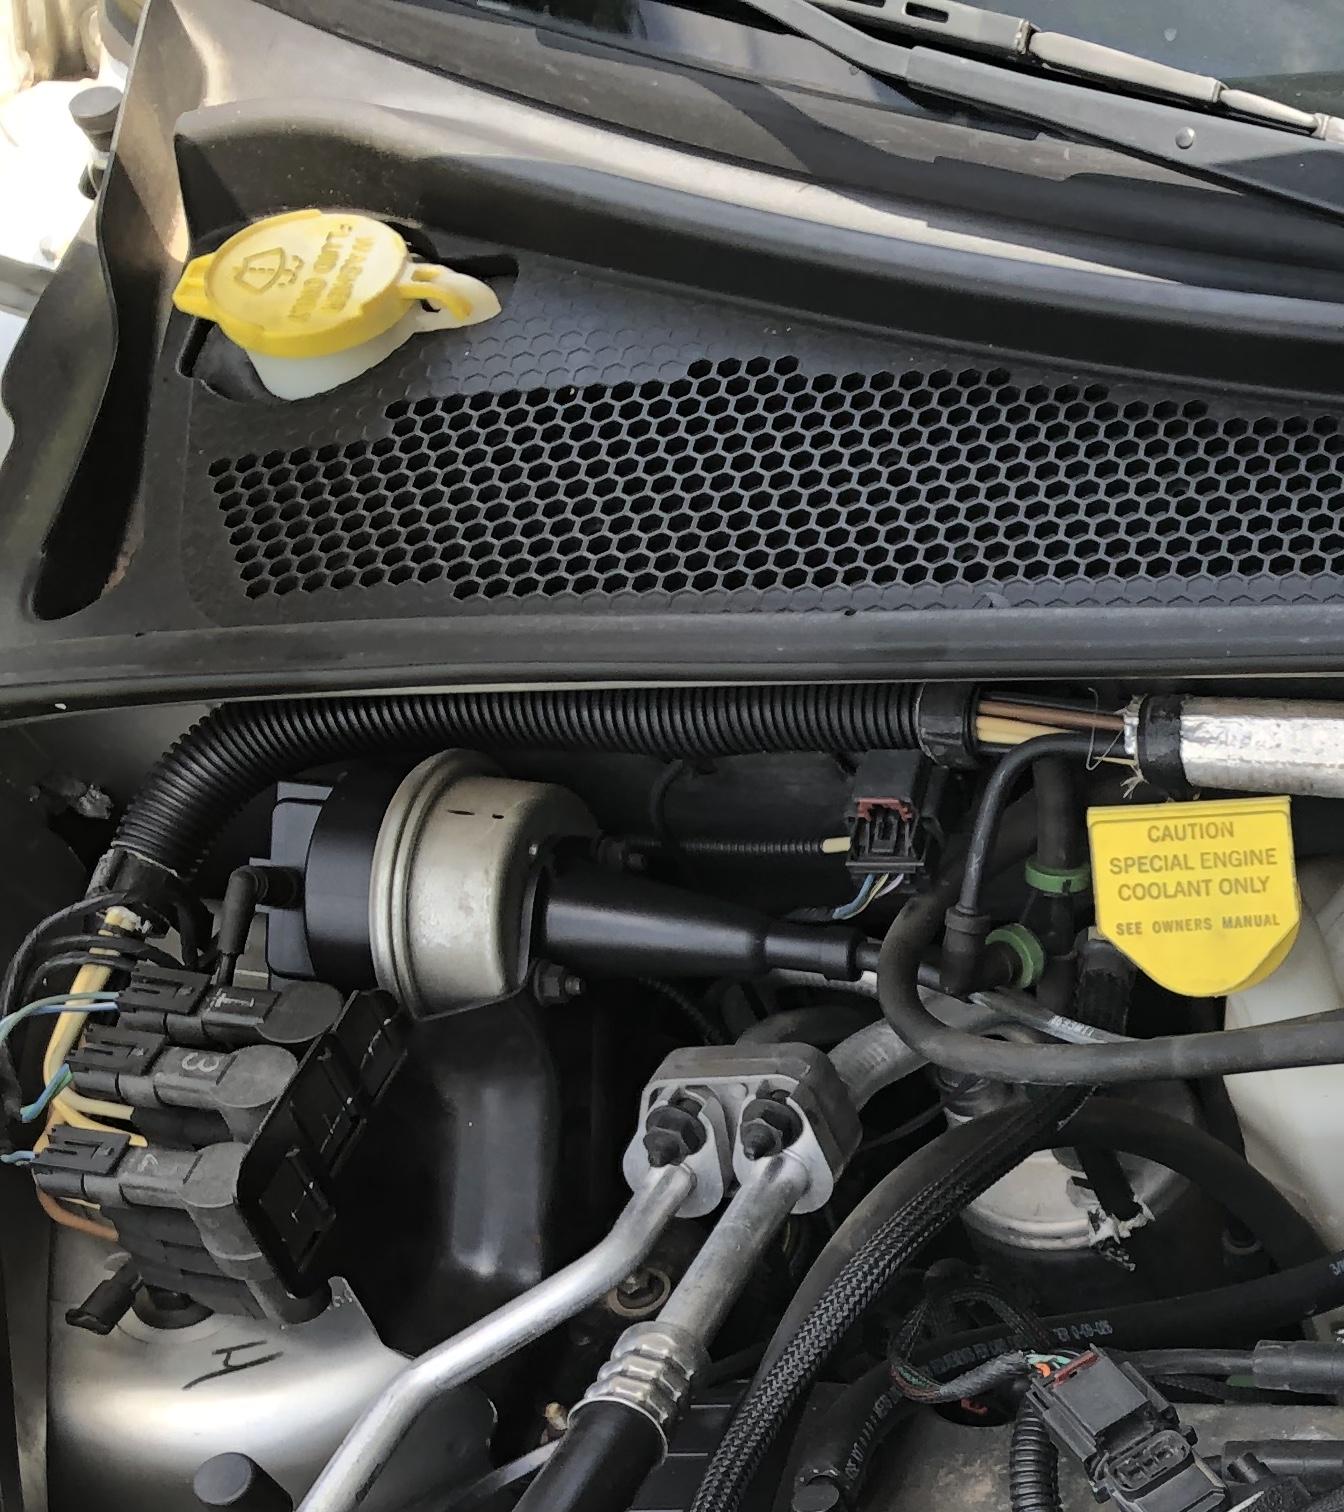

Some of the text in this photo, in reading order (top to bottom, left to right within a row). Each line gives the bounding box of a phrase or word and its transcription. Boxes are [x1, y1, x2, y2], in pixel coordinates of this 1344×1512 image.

[1147, 821, 1235, 843] CAUTION
[1109, 847, 1278, 875] SPECIAL ENGINE
[1117, 875, 1271, 902] COOLANT ONLY
[1115, 913, 1281, 936] SEE OWNERS MANUAL
